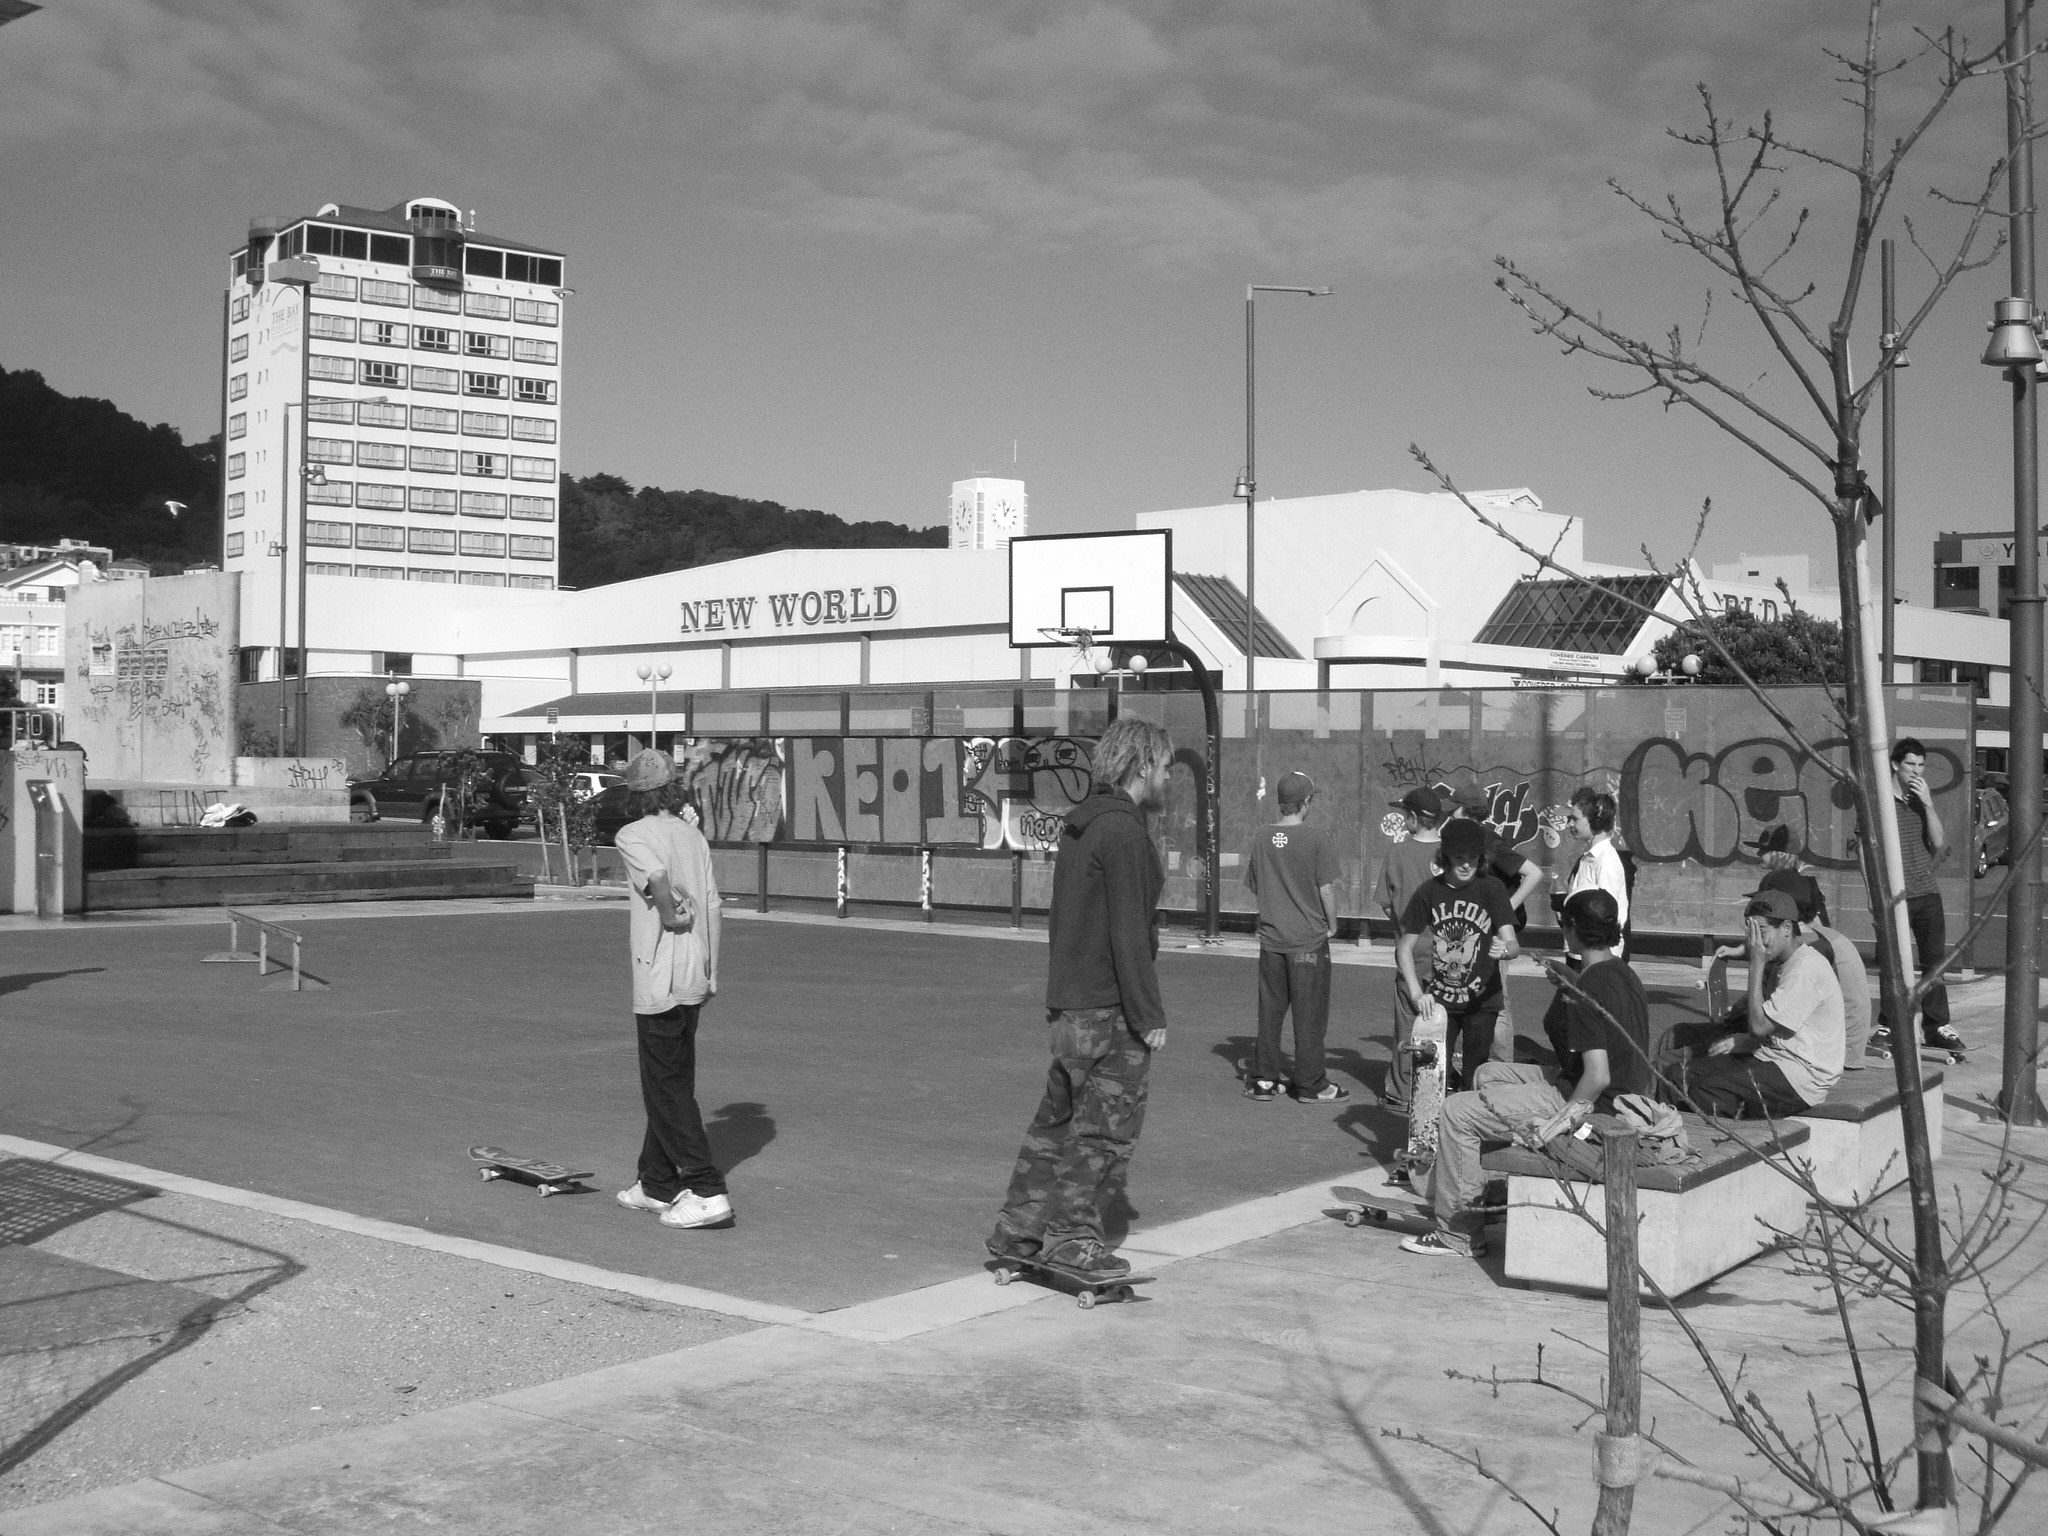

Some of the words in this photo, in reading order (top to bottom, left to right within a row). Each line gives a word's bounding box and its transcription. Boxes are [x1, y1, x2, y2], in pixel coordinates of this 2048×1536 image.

[271, 309, 285, 325] THE
[287, 303, 302, 319] BAY
[681, 597, 756, 633] NEW
[769, 585, 899, 627] WORLD
[1549, 651, 1575, 659] COVERED
